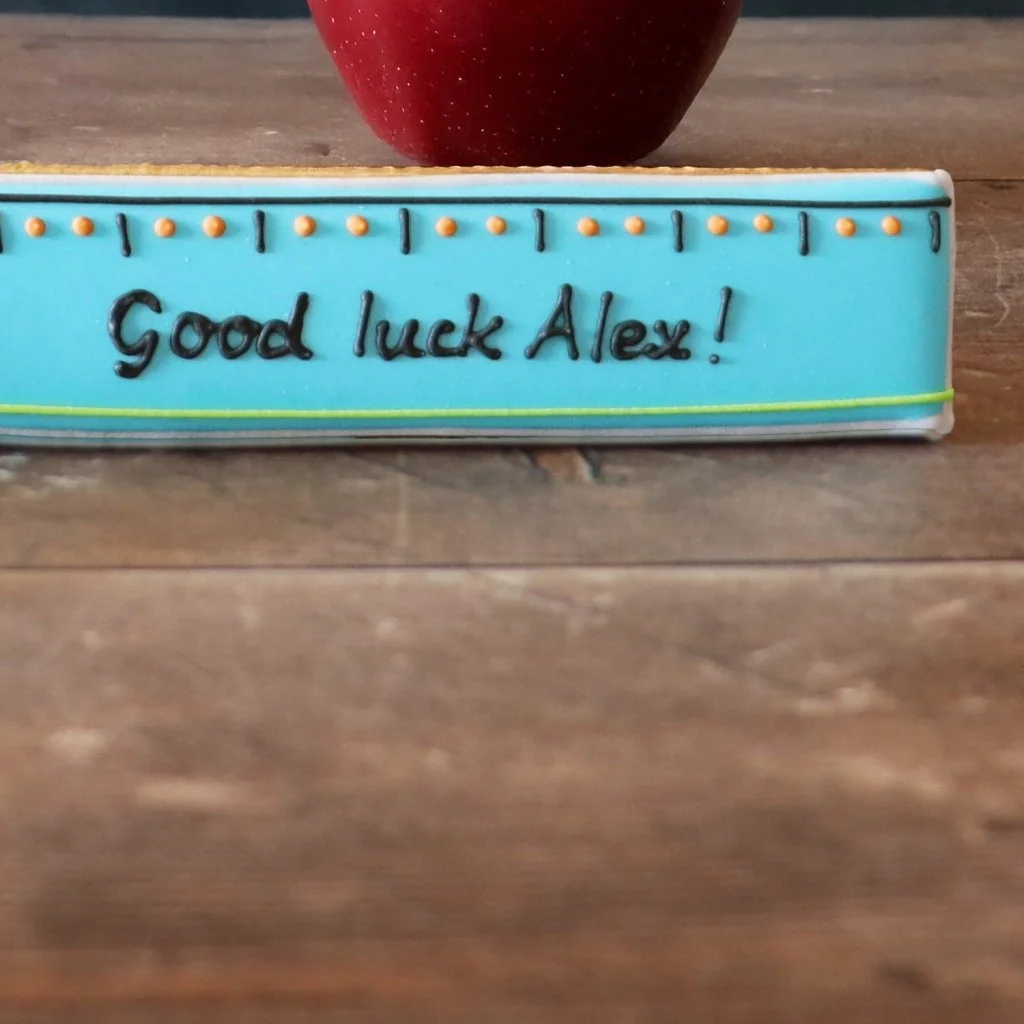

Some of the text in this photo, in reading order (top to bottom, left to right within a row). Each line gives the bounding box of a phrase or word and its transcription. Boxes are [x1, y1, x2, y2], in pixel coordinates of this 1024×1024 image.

[107, 282, 733, 380] Good luck Alex!
